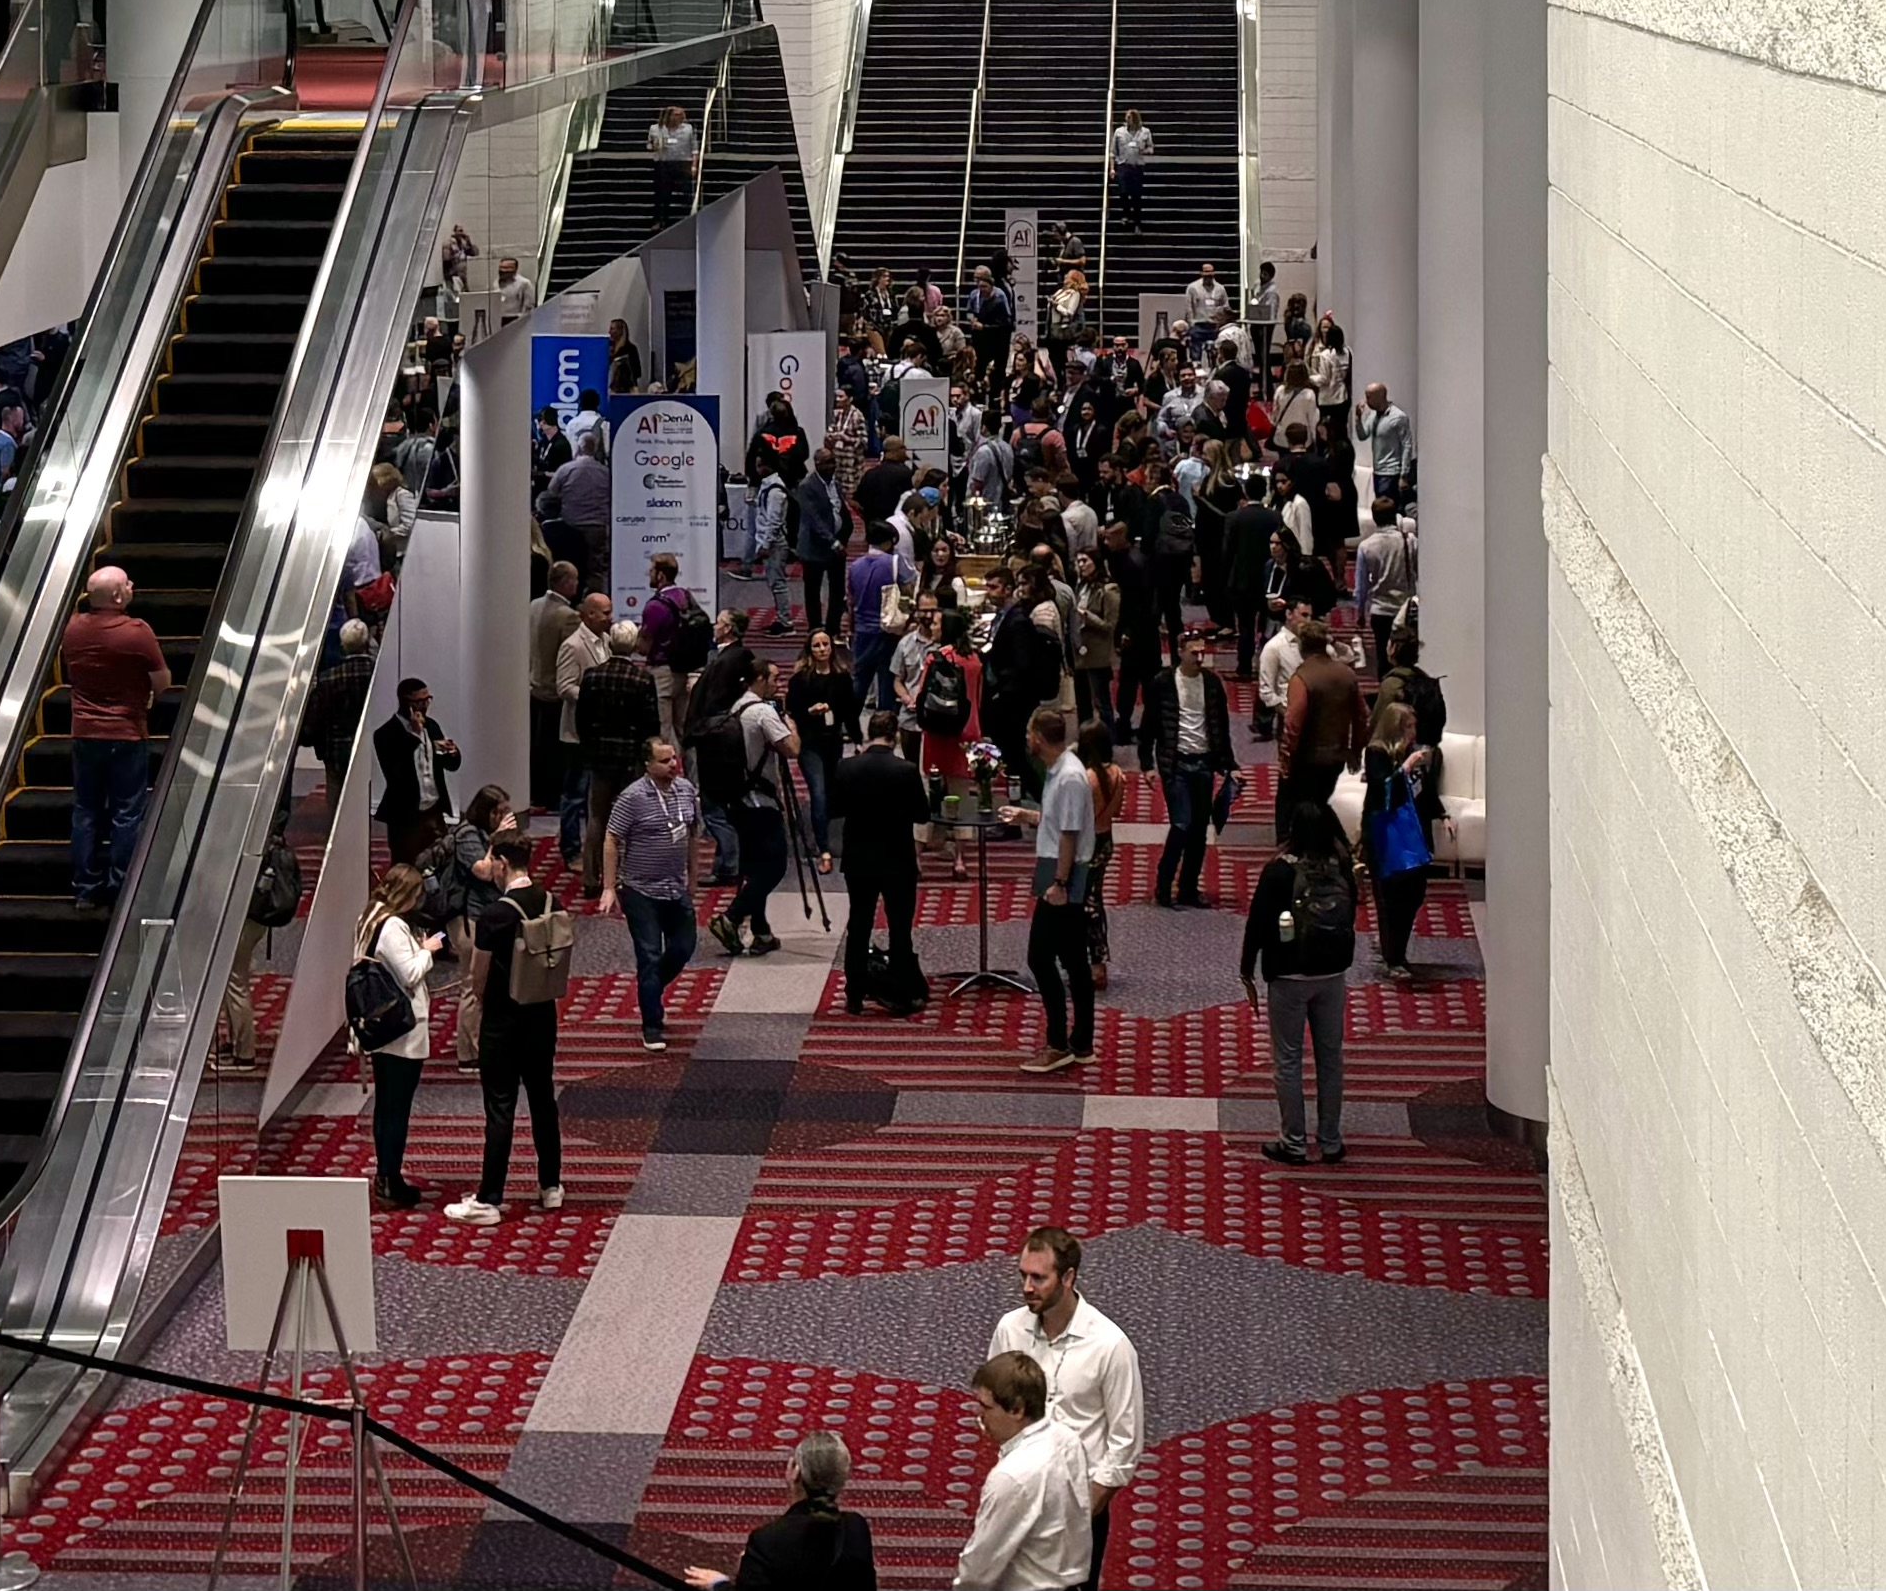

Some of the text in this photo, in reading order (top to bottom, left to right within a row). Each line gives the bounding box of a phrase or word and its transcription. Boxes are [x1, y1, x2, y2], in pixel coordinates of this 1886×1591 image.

[779, 354, 799, 403] Goo
[550, 349, 580, 432] alom
[636, 413, 659, 434] AI
[912, 407, 936, 428] AI
[634, 450, 695, 470] Google
[646, 497, 683, 508] slalom
